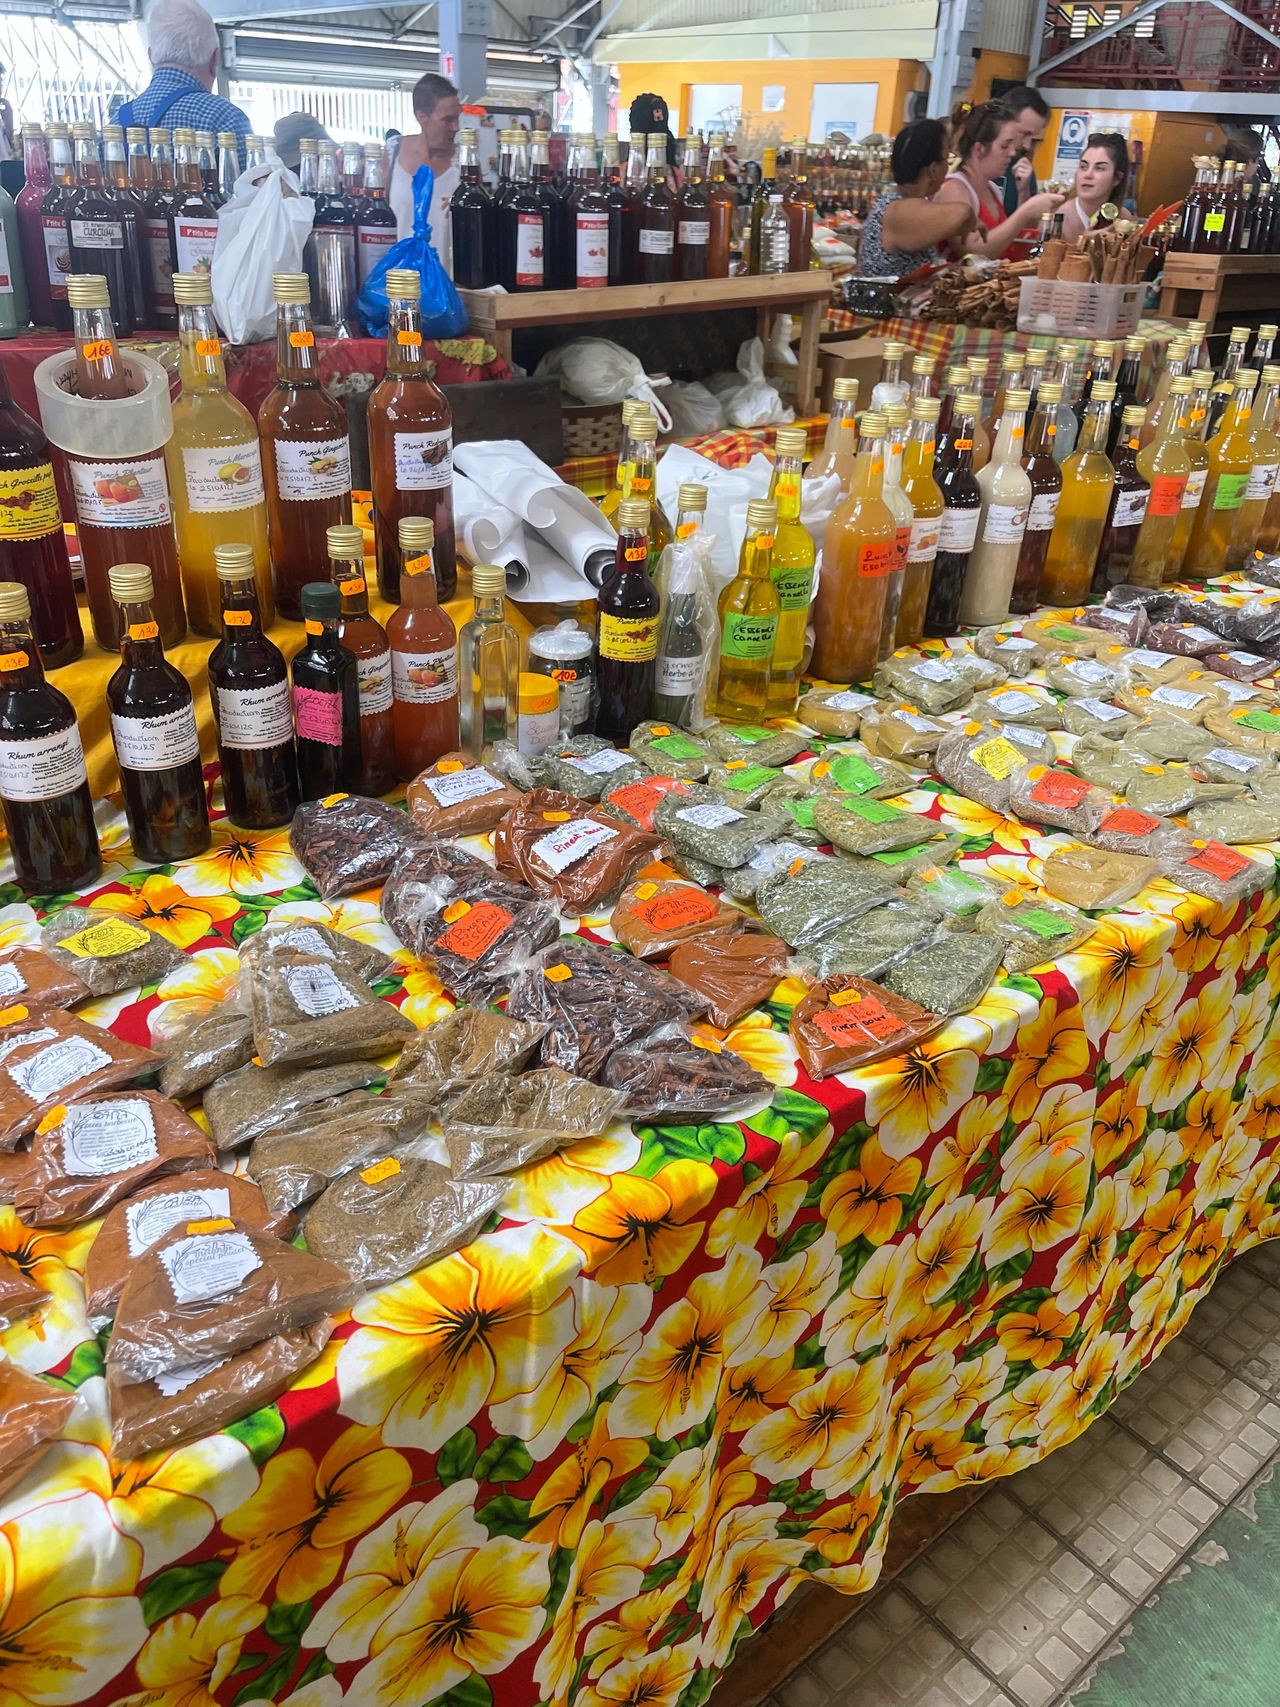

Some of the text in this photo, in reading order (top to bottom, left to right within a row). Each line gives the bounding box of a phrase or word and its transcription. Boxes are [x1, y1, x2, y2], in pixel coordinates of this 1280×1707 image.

[87, 341, 111, 358] 16€
[298, 448, 321, 457] Punch
[627, 549, 645, 560] 13€
[776, 582, 811, 590] ESSENCE
[739, 626, 776, 634] ESSENCE
[554, 671, 577, 681] 10€
[239, 696, 265, 706] Rhum
[141, 720, 168, 730] Rhum
[7, 751, 36, 760] Rhum
